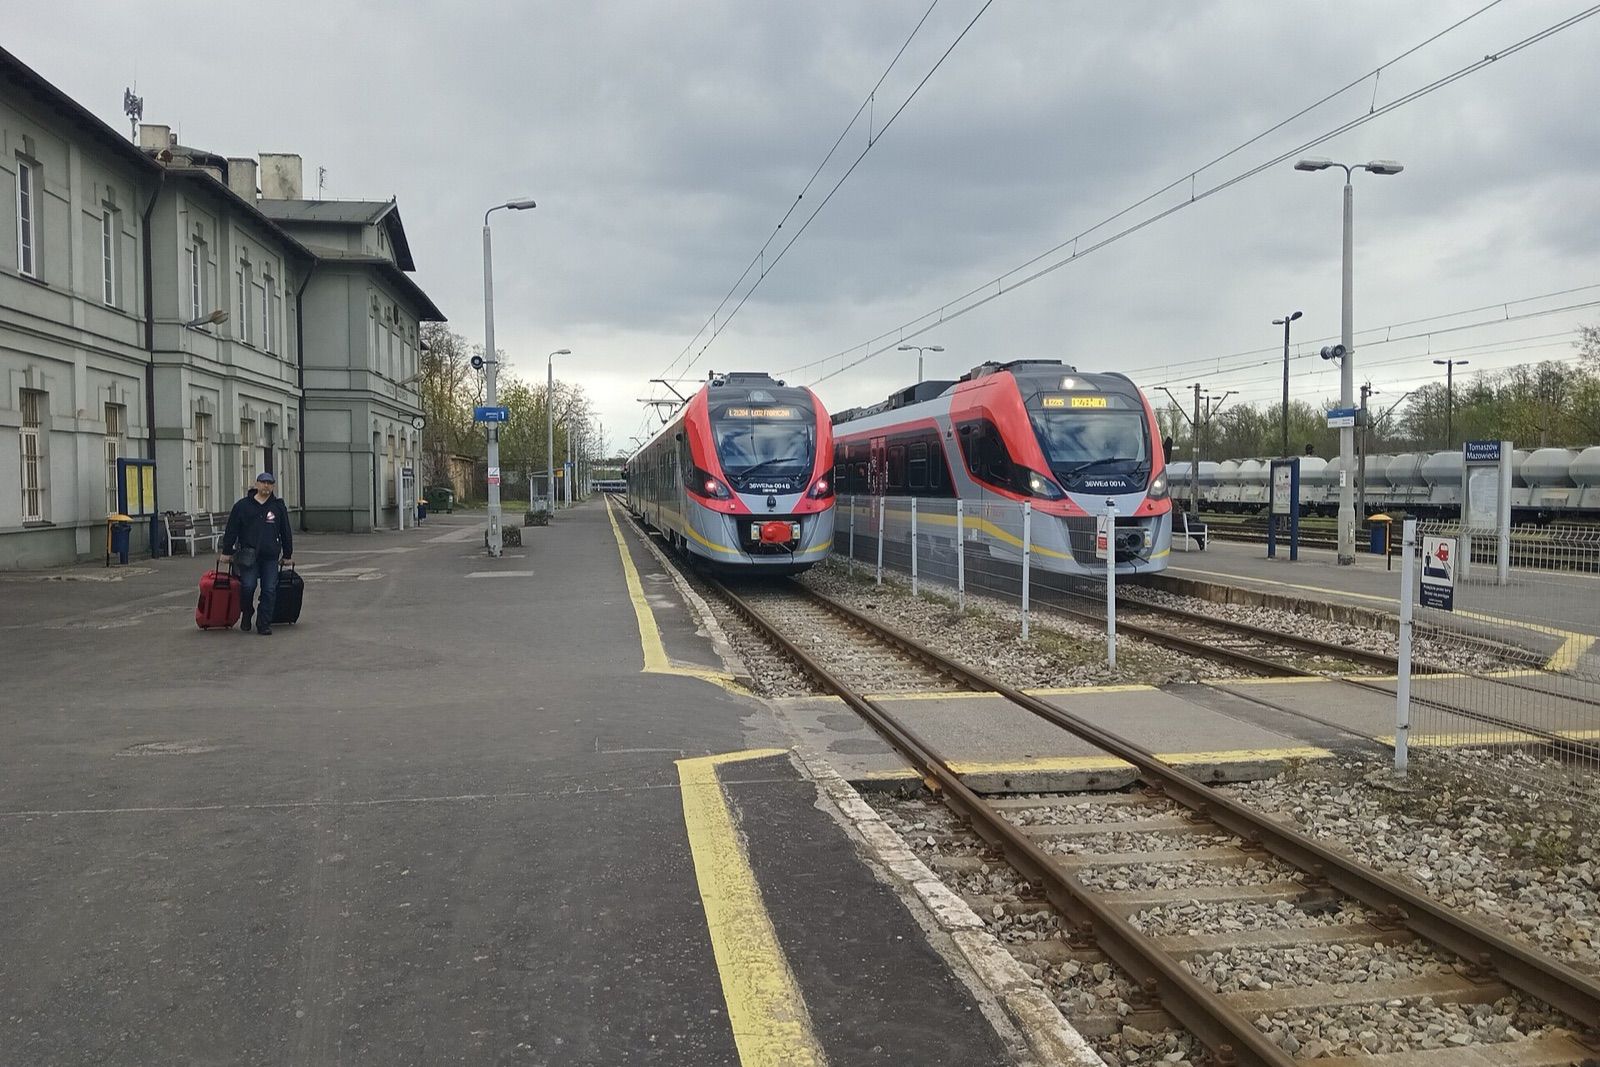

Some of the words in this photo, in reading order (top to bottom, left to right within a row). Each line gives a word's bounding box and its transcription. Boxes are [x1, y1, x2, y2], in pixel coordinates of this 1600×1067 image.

[500, 411, 505, 420] 1
[1468, 442, 1499, 451] Tomaszów
[1466, 452, 1500, 460] Mazowiecki
